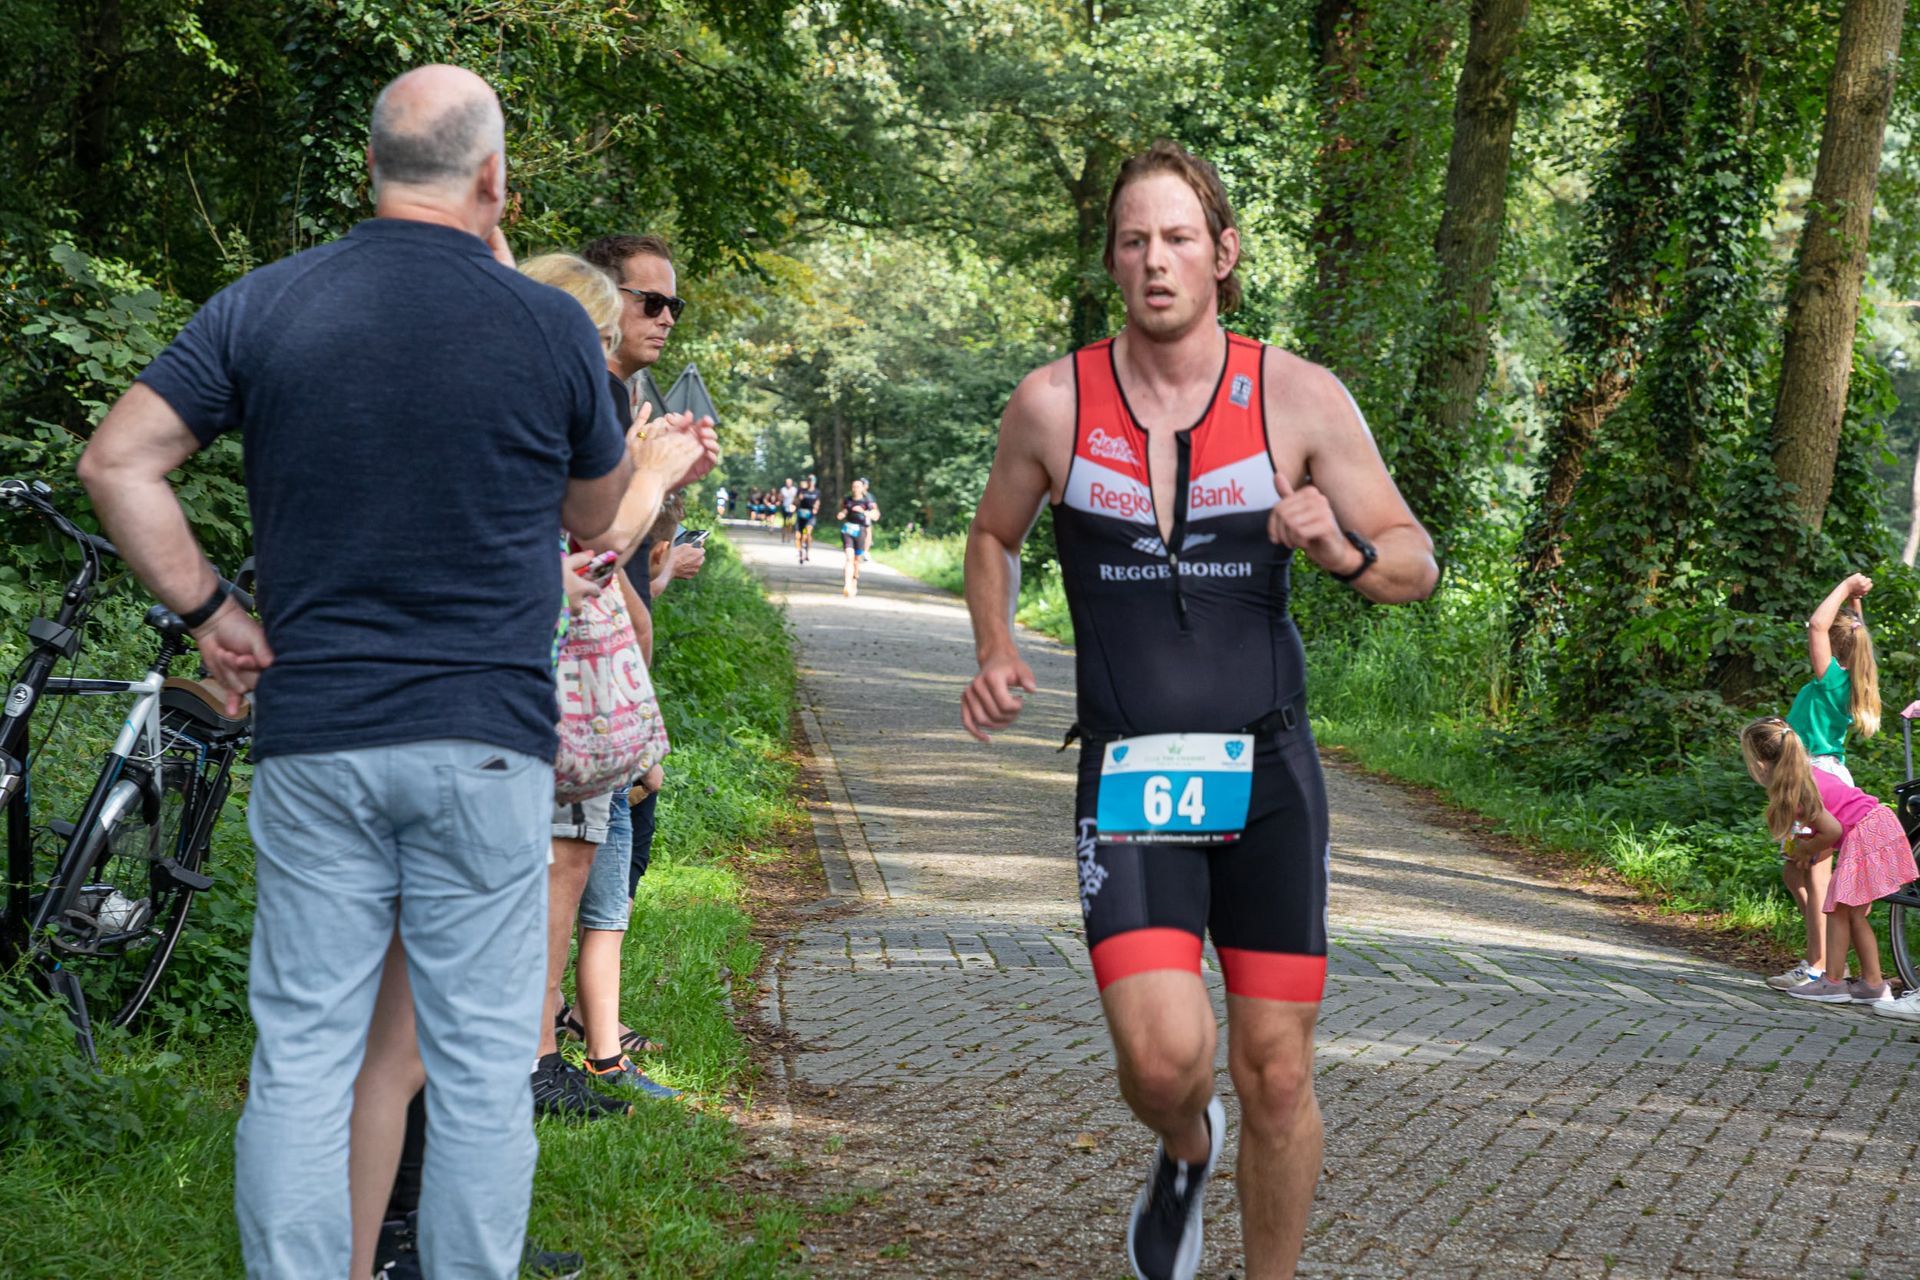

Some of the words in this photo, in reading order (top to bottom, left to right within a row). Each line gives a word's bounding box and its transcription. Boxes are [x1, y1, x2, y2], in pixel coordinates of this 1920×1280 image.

[1090, 483, 1150, 516] Regio
[1191, 478, 1246, 509] Bank
[1143, 775, 1206, 826] 64
